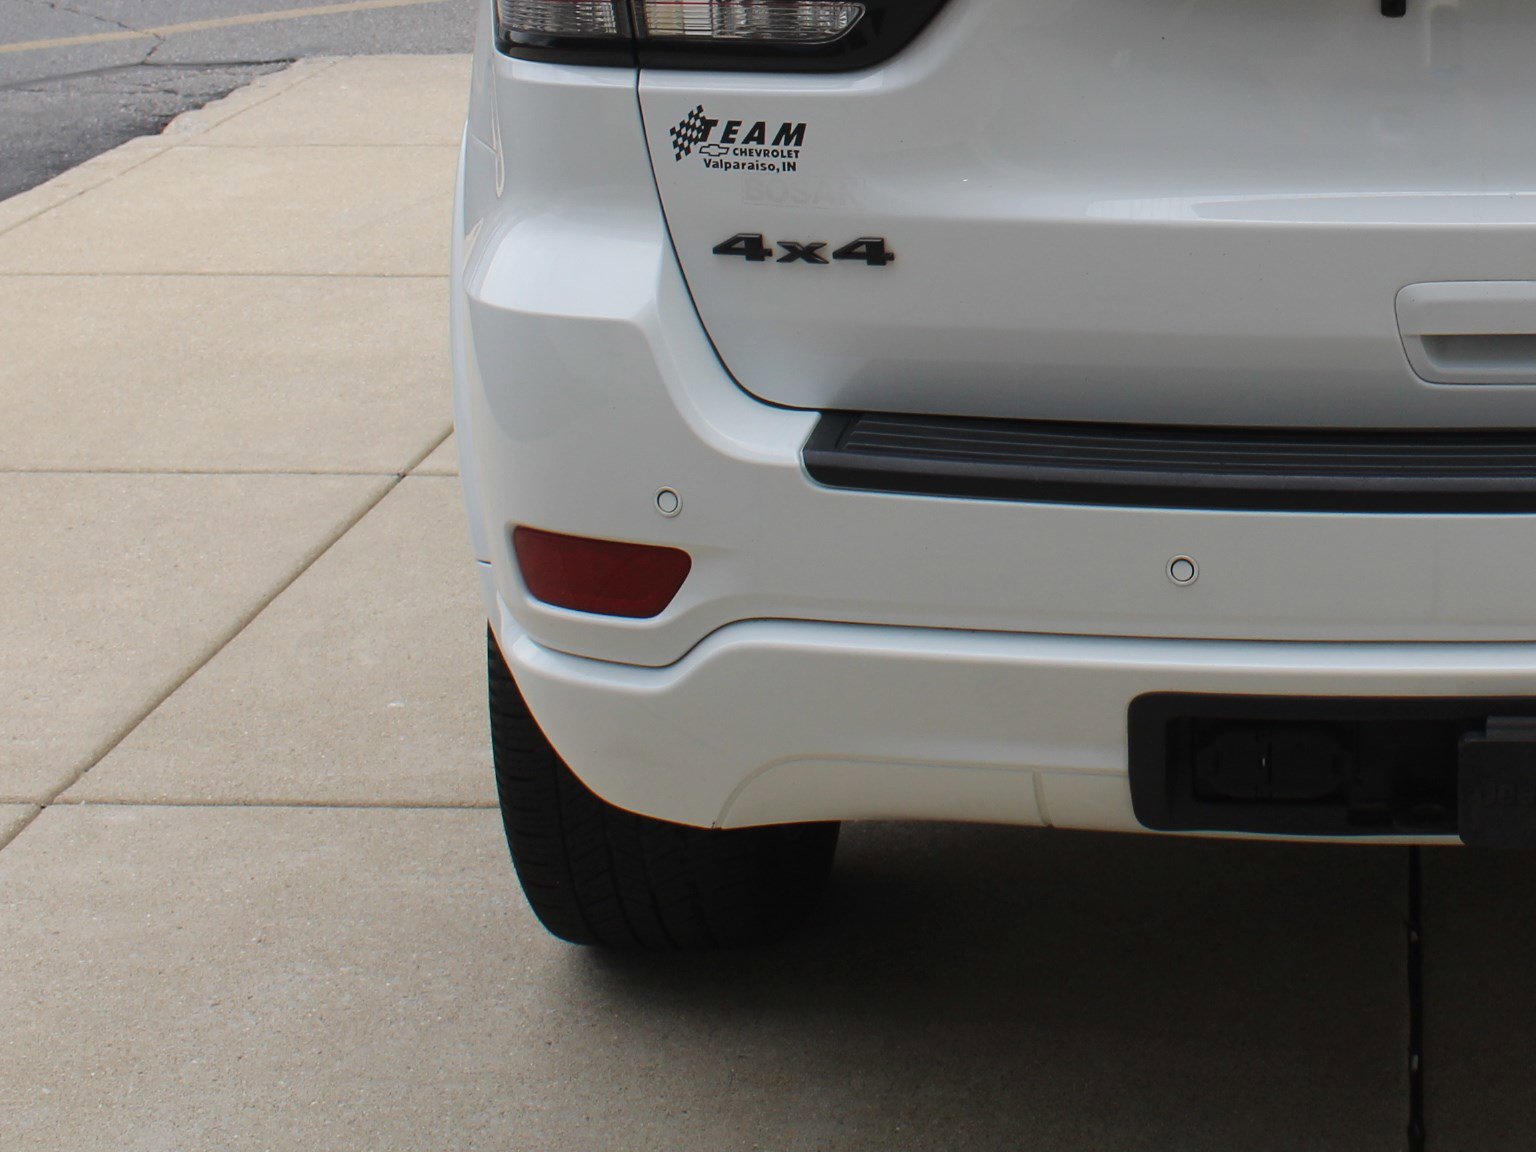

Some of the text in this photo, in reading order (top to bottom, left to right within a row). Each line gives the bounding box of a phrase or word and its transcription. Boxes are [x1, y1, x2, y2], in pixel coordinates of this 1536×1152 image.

[700, 118, 807, 147] TEAM
[732, 147, 800, 159] CHEVROLET
[703, 157, 797, 174] Valparaiso, IN
[712, 232, 896, 267] 4x4
